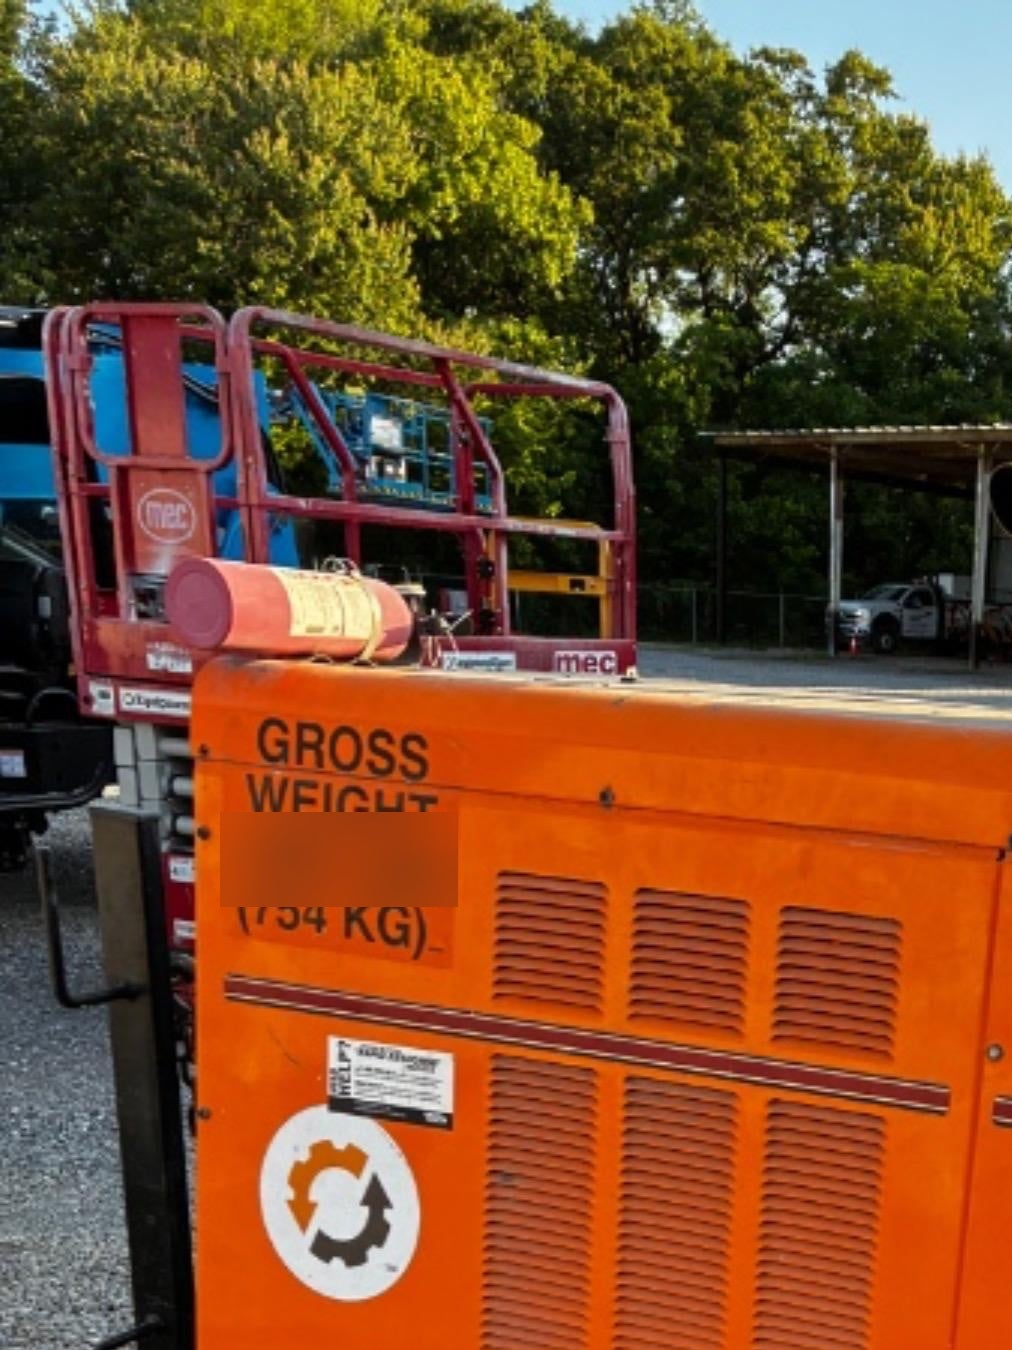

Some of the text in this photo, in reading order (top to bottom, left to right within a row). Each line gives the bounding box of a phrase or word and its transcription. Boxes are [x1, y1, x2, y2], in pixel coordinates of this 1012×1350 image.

[146, 501, 187, 529] mec
[557, 652, 616, 673] mec
[256, 717, 429, 782] GROSS
